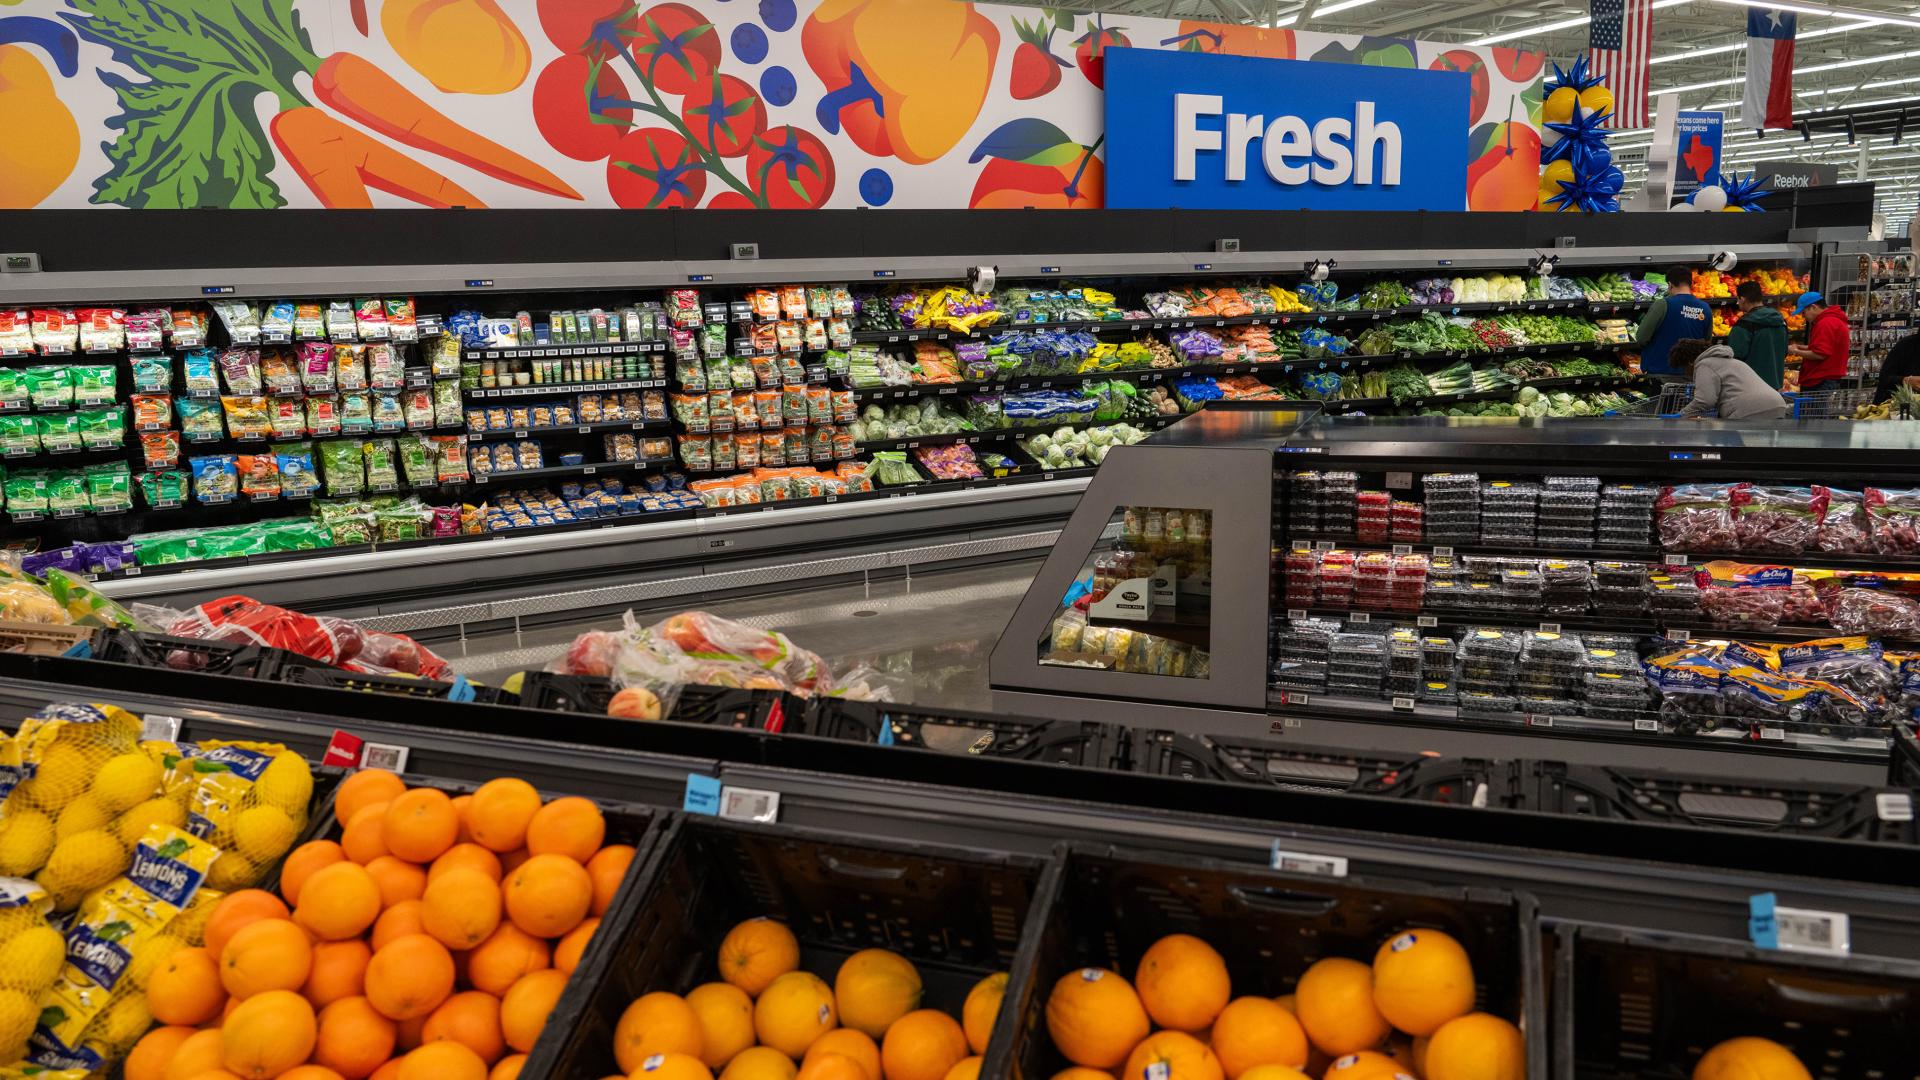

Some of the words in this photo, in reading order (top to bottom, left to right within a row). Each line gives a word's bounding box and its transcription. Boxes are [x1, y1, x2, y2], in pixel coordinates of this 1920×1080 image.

[1173, 93, 1402, 186] Fresh
[1691, 124, 1708, 133] prices
[1774, 173, 1809, 188] Reebok
[1683, 305, 1703, 313] Happy
[130, 854, 188, 891] LEMONS
[67, 933, 125, 975] LEMONS
